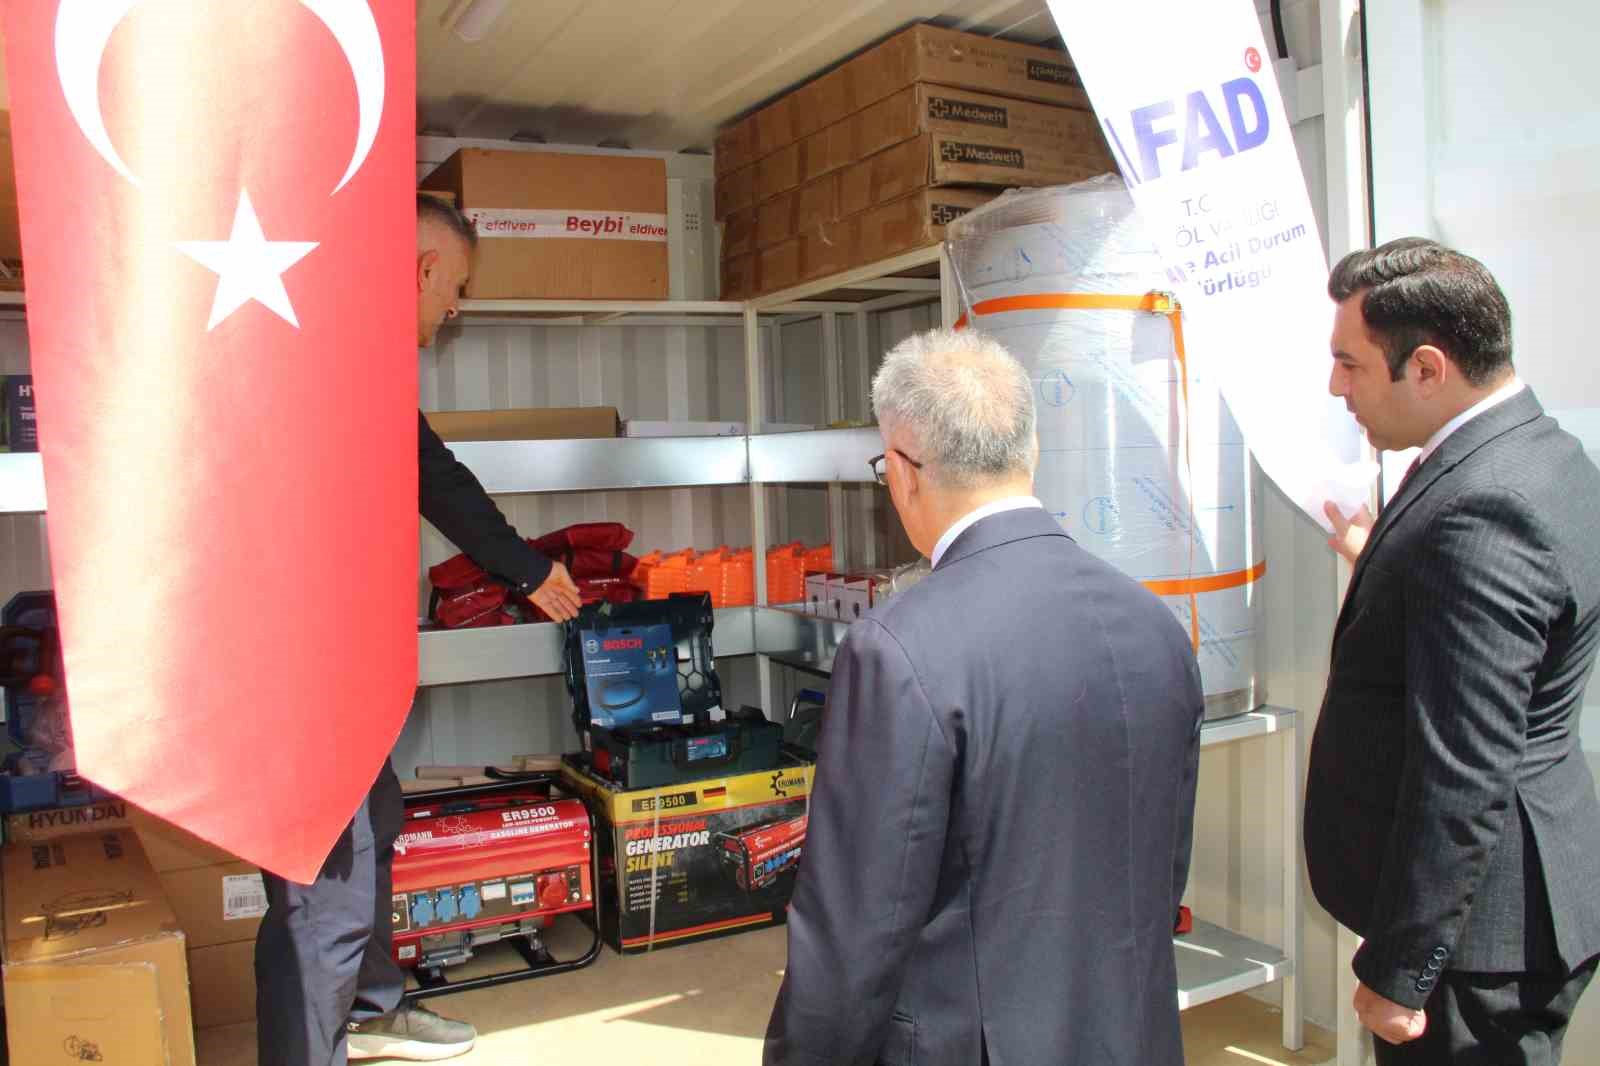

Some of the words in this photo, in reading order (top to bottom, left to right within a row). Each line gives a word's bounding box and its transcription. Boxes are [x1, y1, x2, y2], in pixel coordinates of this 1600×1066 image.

[565, 216, 624, 236] Beybi
[1175, 225, 1205, 248] ÖL
[1204, 242, 1241, 269] Acil
[1248, 224, 1307, 254] Durum
[602, 638, 643, 650] BOSCH
[29, 803, 126, 829] HYUNDAI
[502, 806, 556, 822] ER9500
[626, 830, 710, 856] GENERATOR
